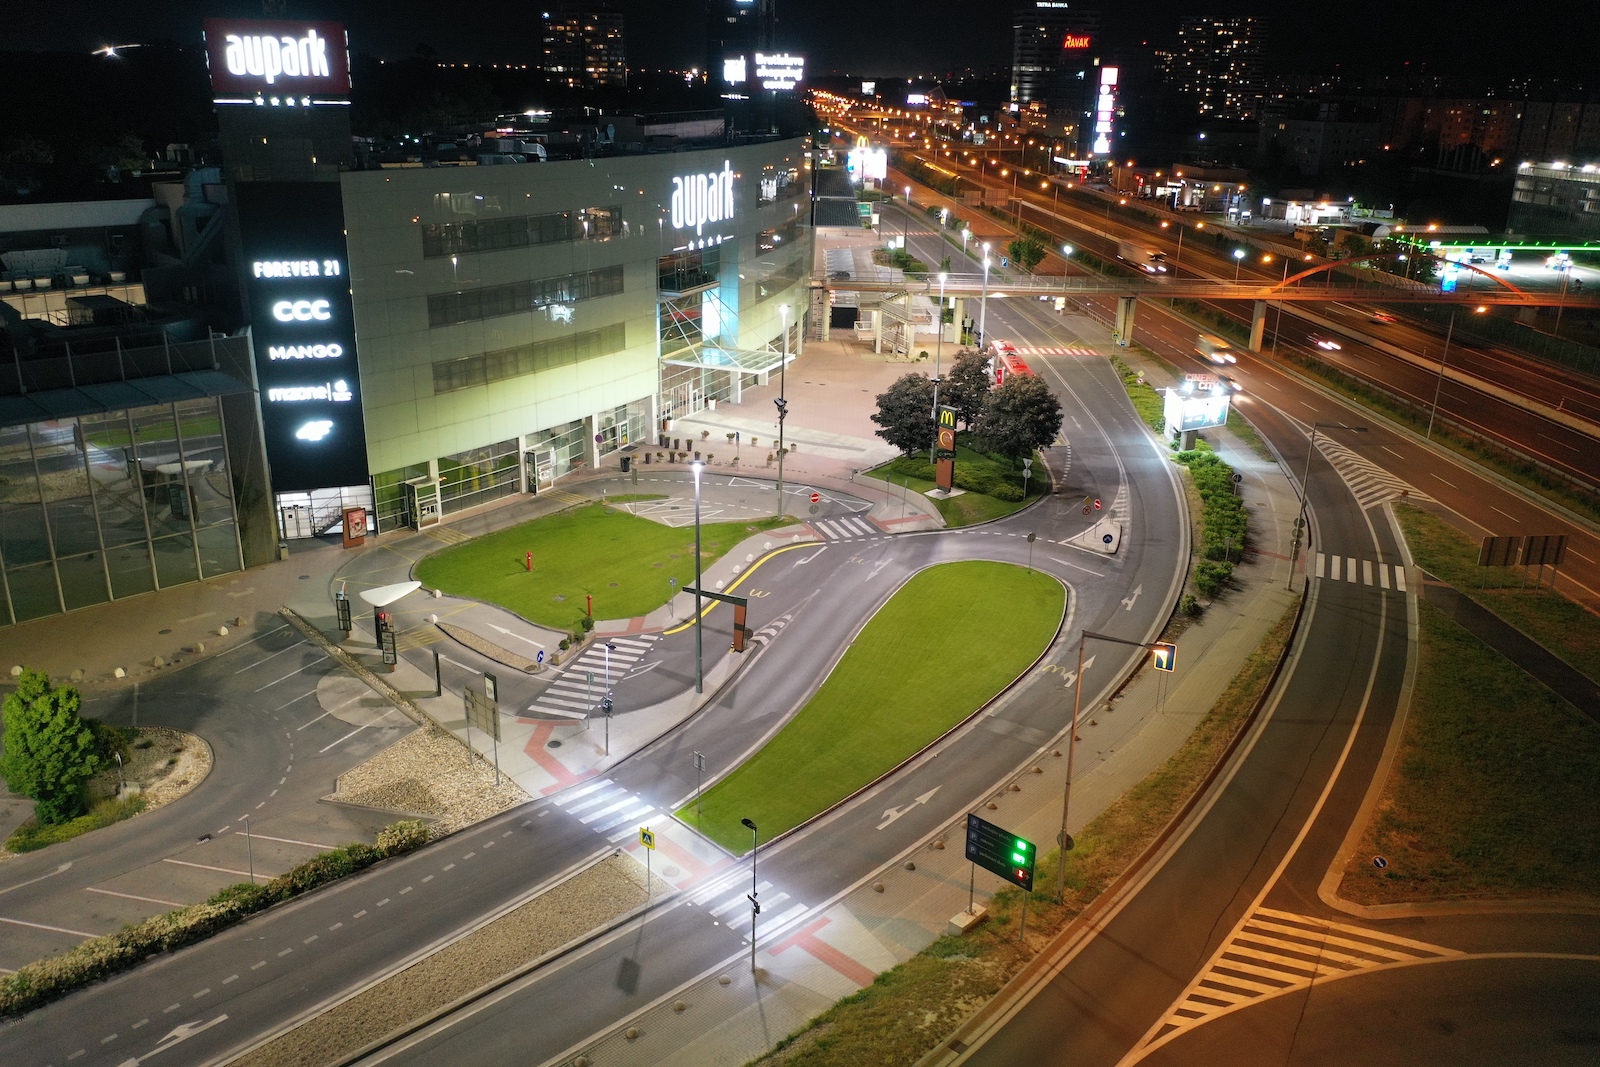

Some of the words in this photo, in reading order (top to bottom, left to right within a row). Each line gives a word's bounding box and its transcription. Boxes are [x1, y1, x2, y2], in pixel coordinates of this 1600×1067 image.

[1064, 36, 1089, 48] RAVAK
[226, 29, 330, 85] aupark
[671, 160, 734, 236] aupark
[253, 261, 320, 278] FOREVER
[323, 259, 341, 276] 21
[273, 299, 332, 322] CCC
[268, 343, 343, 360] MANGO
[1185, 373, 1219, 382] CINEMA
[1198, 381, 1219, 390] CITY
